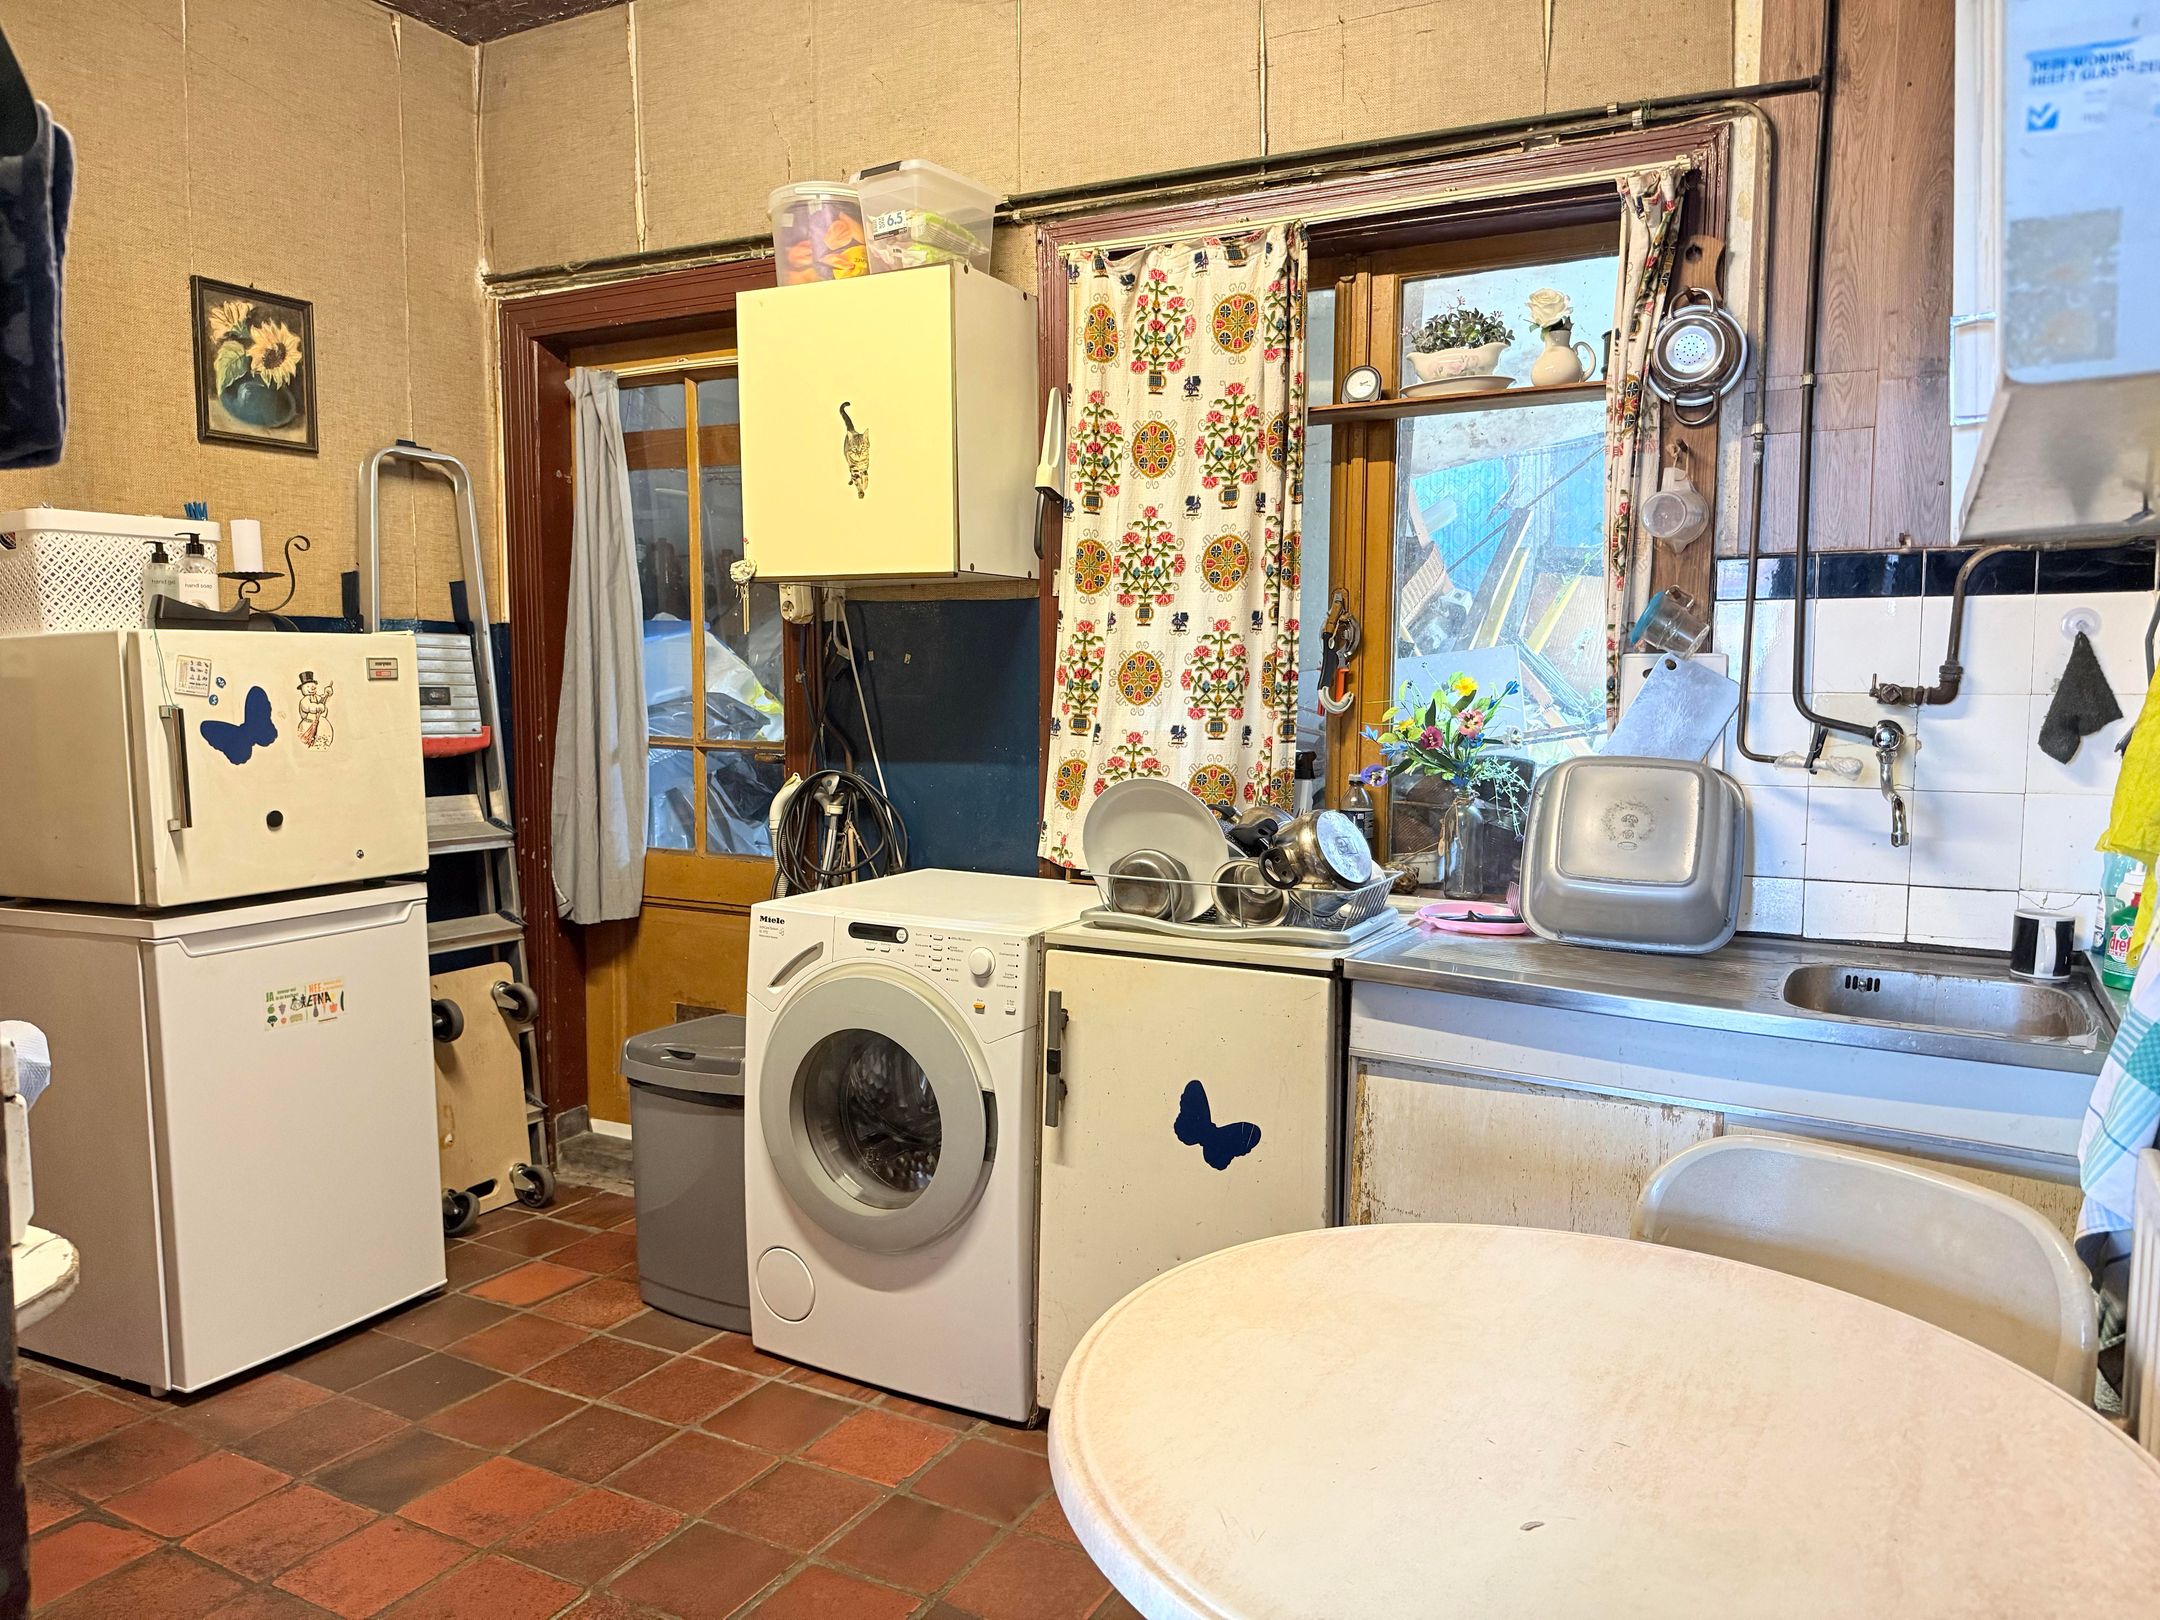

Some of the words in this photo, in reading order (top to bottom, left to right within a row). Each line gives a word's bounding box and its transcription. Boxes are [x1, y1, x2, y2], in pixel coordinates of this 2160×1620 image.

[886, 211, 903, 227] 6.5
[759, 915, 785, 925] Miele
[2109, 933, 2132, 953] dref
[265, 991, 275, 1003] JA
[306, 991, 332, 1007] ETNA
